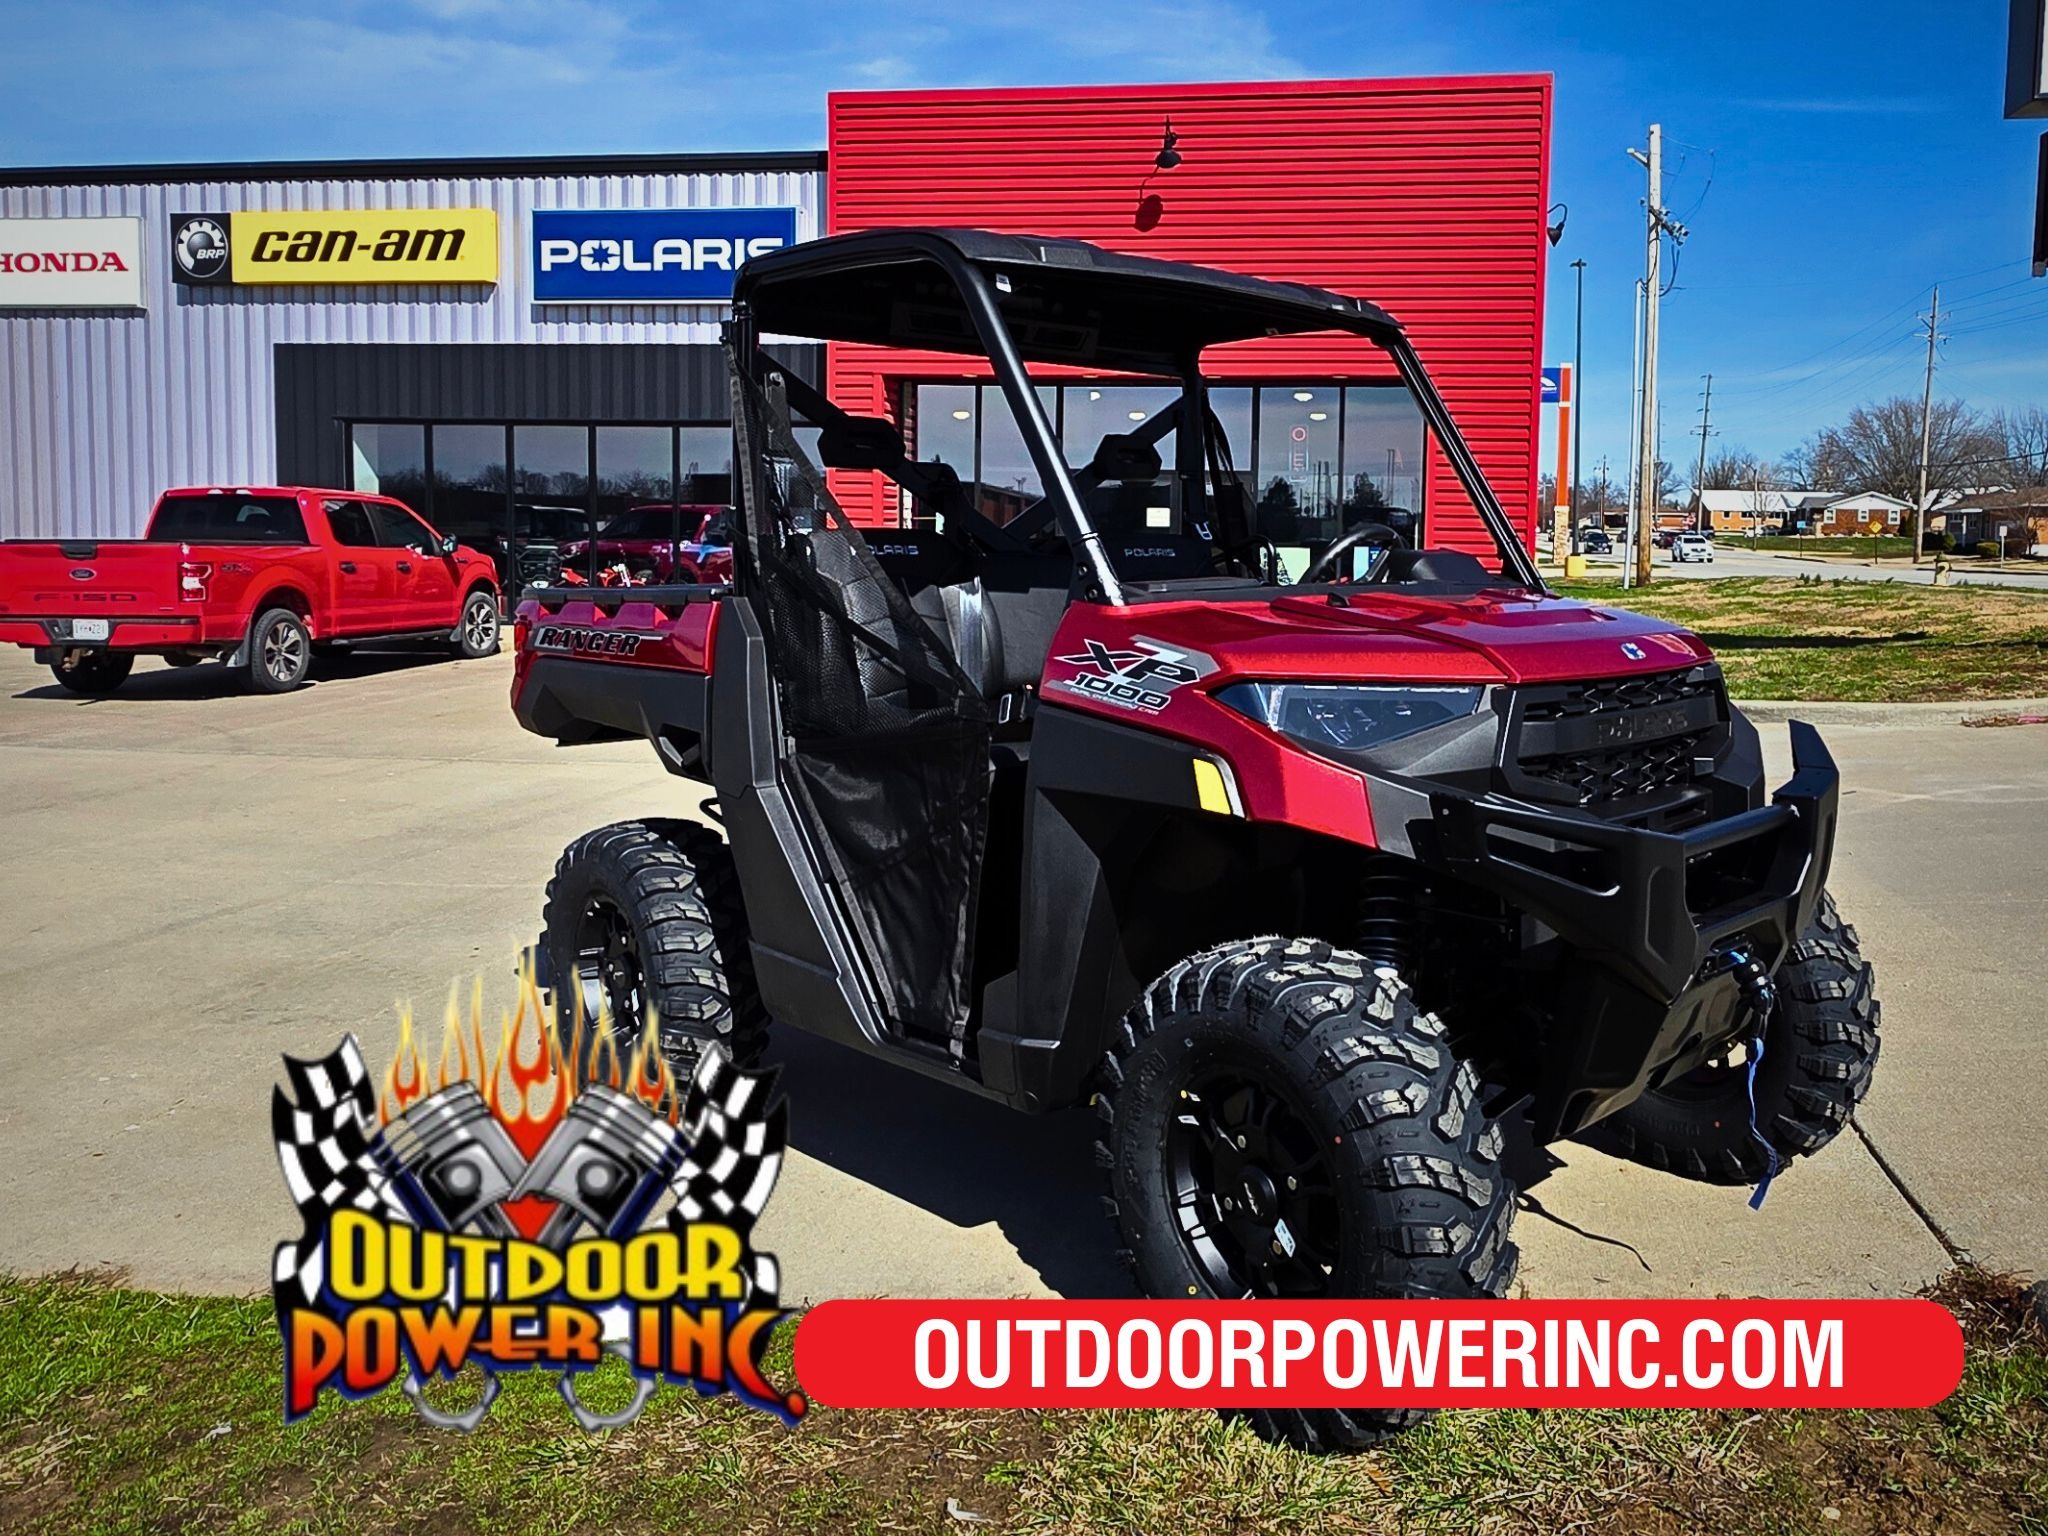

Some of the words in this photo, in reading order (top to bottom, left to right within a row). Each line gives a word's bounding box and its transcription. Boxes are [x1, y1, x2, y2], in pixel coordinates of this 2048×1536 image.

[196, 248, 226, 259] BRP
[250, 228, 466, 262] can-am
[1124, 548, 1176, 557] POLARIS
[534, 626, 641, 657] RANGER
[1053, 638, 1201, 686] XP
[1074, 672, 1172, 710] 1000
